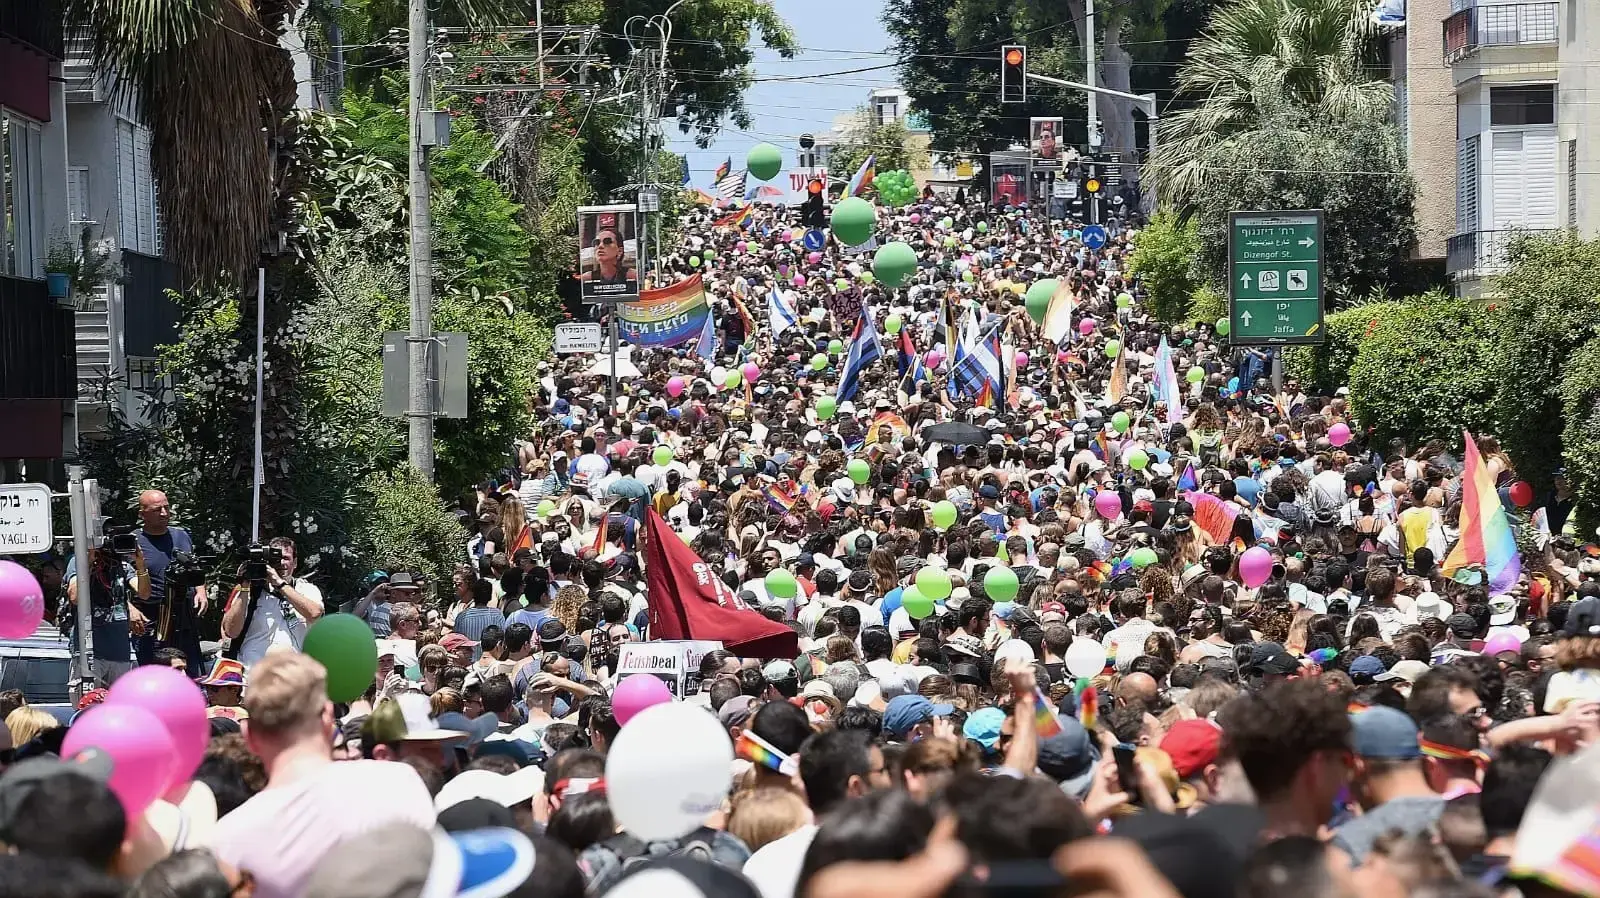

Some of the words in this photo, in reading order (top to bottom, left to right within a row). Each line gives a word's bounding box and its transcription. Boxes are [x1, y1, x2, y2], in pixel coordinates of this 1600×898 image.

[1243, 250, 1279, 259] Dizengof
[1273, 325, 1295, 333] Jaffa
[1, 533, 28, 545] YAGLI
